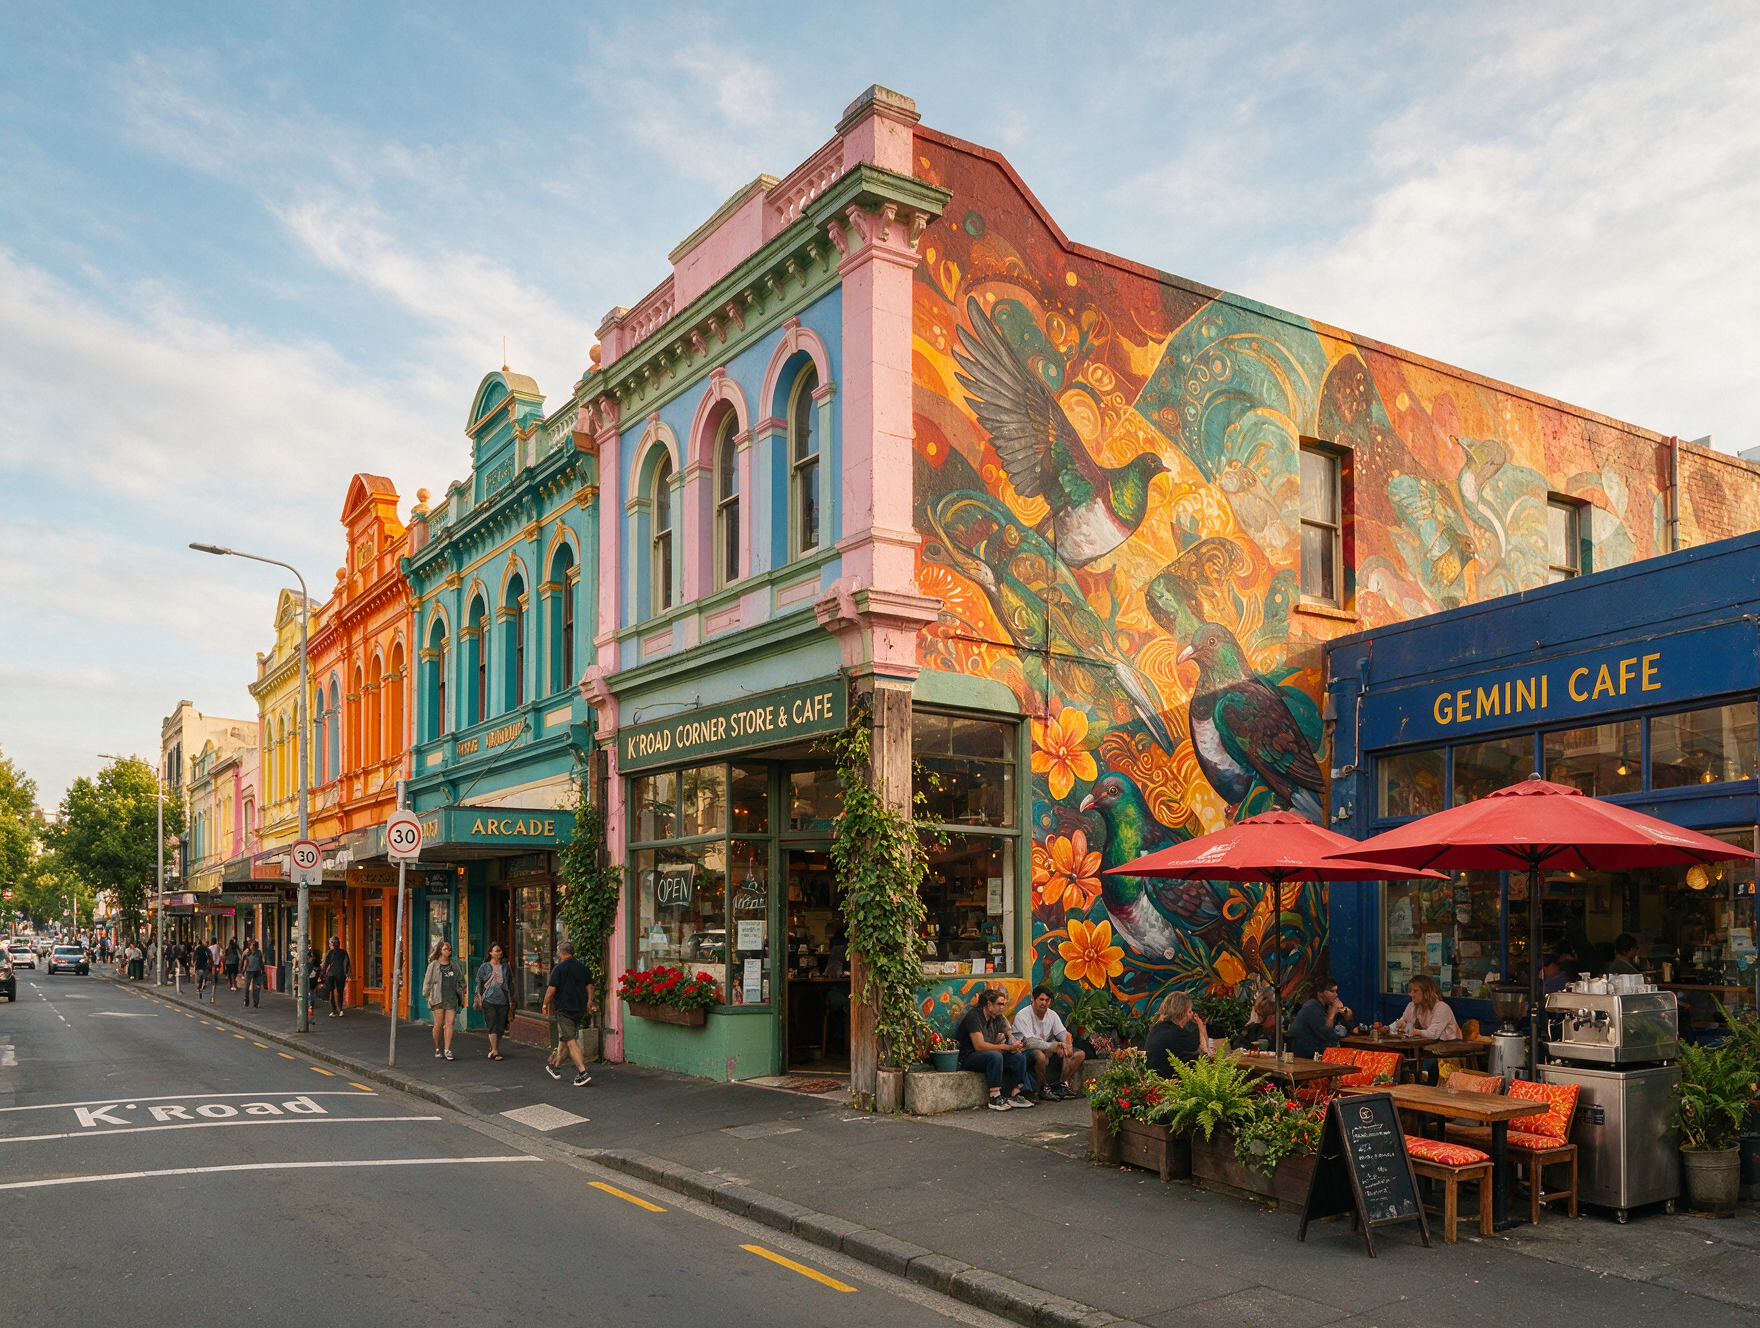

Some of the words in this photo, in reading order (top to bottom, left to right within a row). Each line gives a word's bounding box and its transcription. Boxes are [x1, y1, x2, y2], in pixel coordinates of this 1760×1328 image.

[1433, 674, 1548, 725] GEMINI
[1568, 652, 1662, 702] CAFE
[627, 729, 671, 760] K'ROAD
[675, 716, 727, 750] CORNER
[730, 705, 774, 738] STORE
[777, 705, 789, 729] &
[792, 692, 833, 725] CAFE
[393, 829, 416, 844] 30
[470, 818, 556, 837] ARCADE
[297, 850, 316, 864] 30
[657, 876, 690, 903] OPEN
